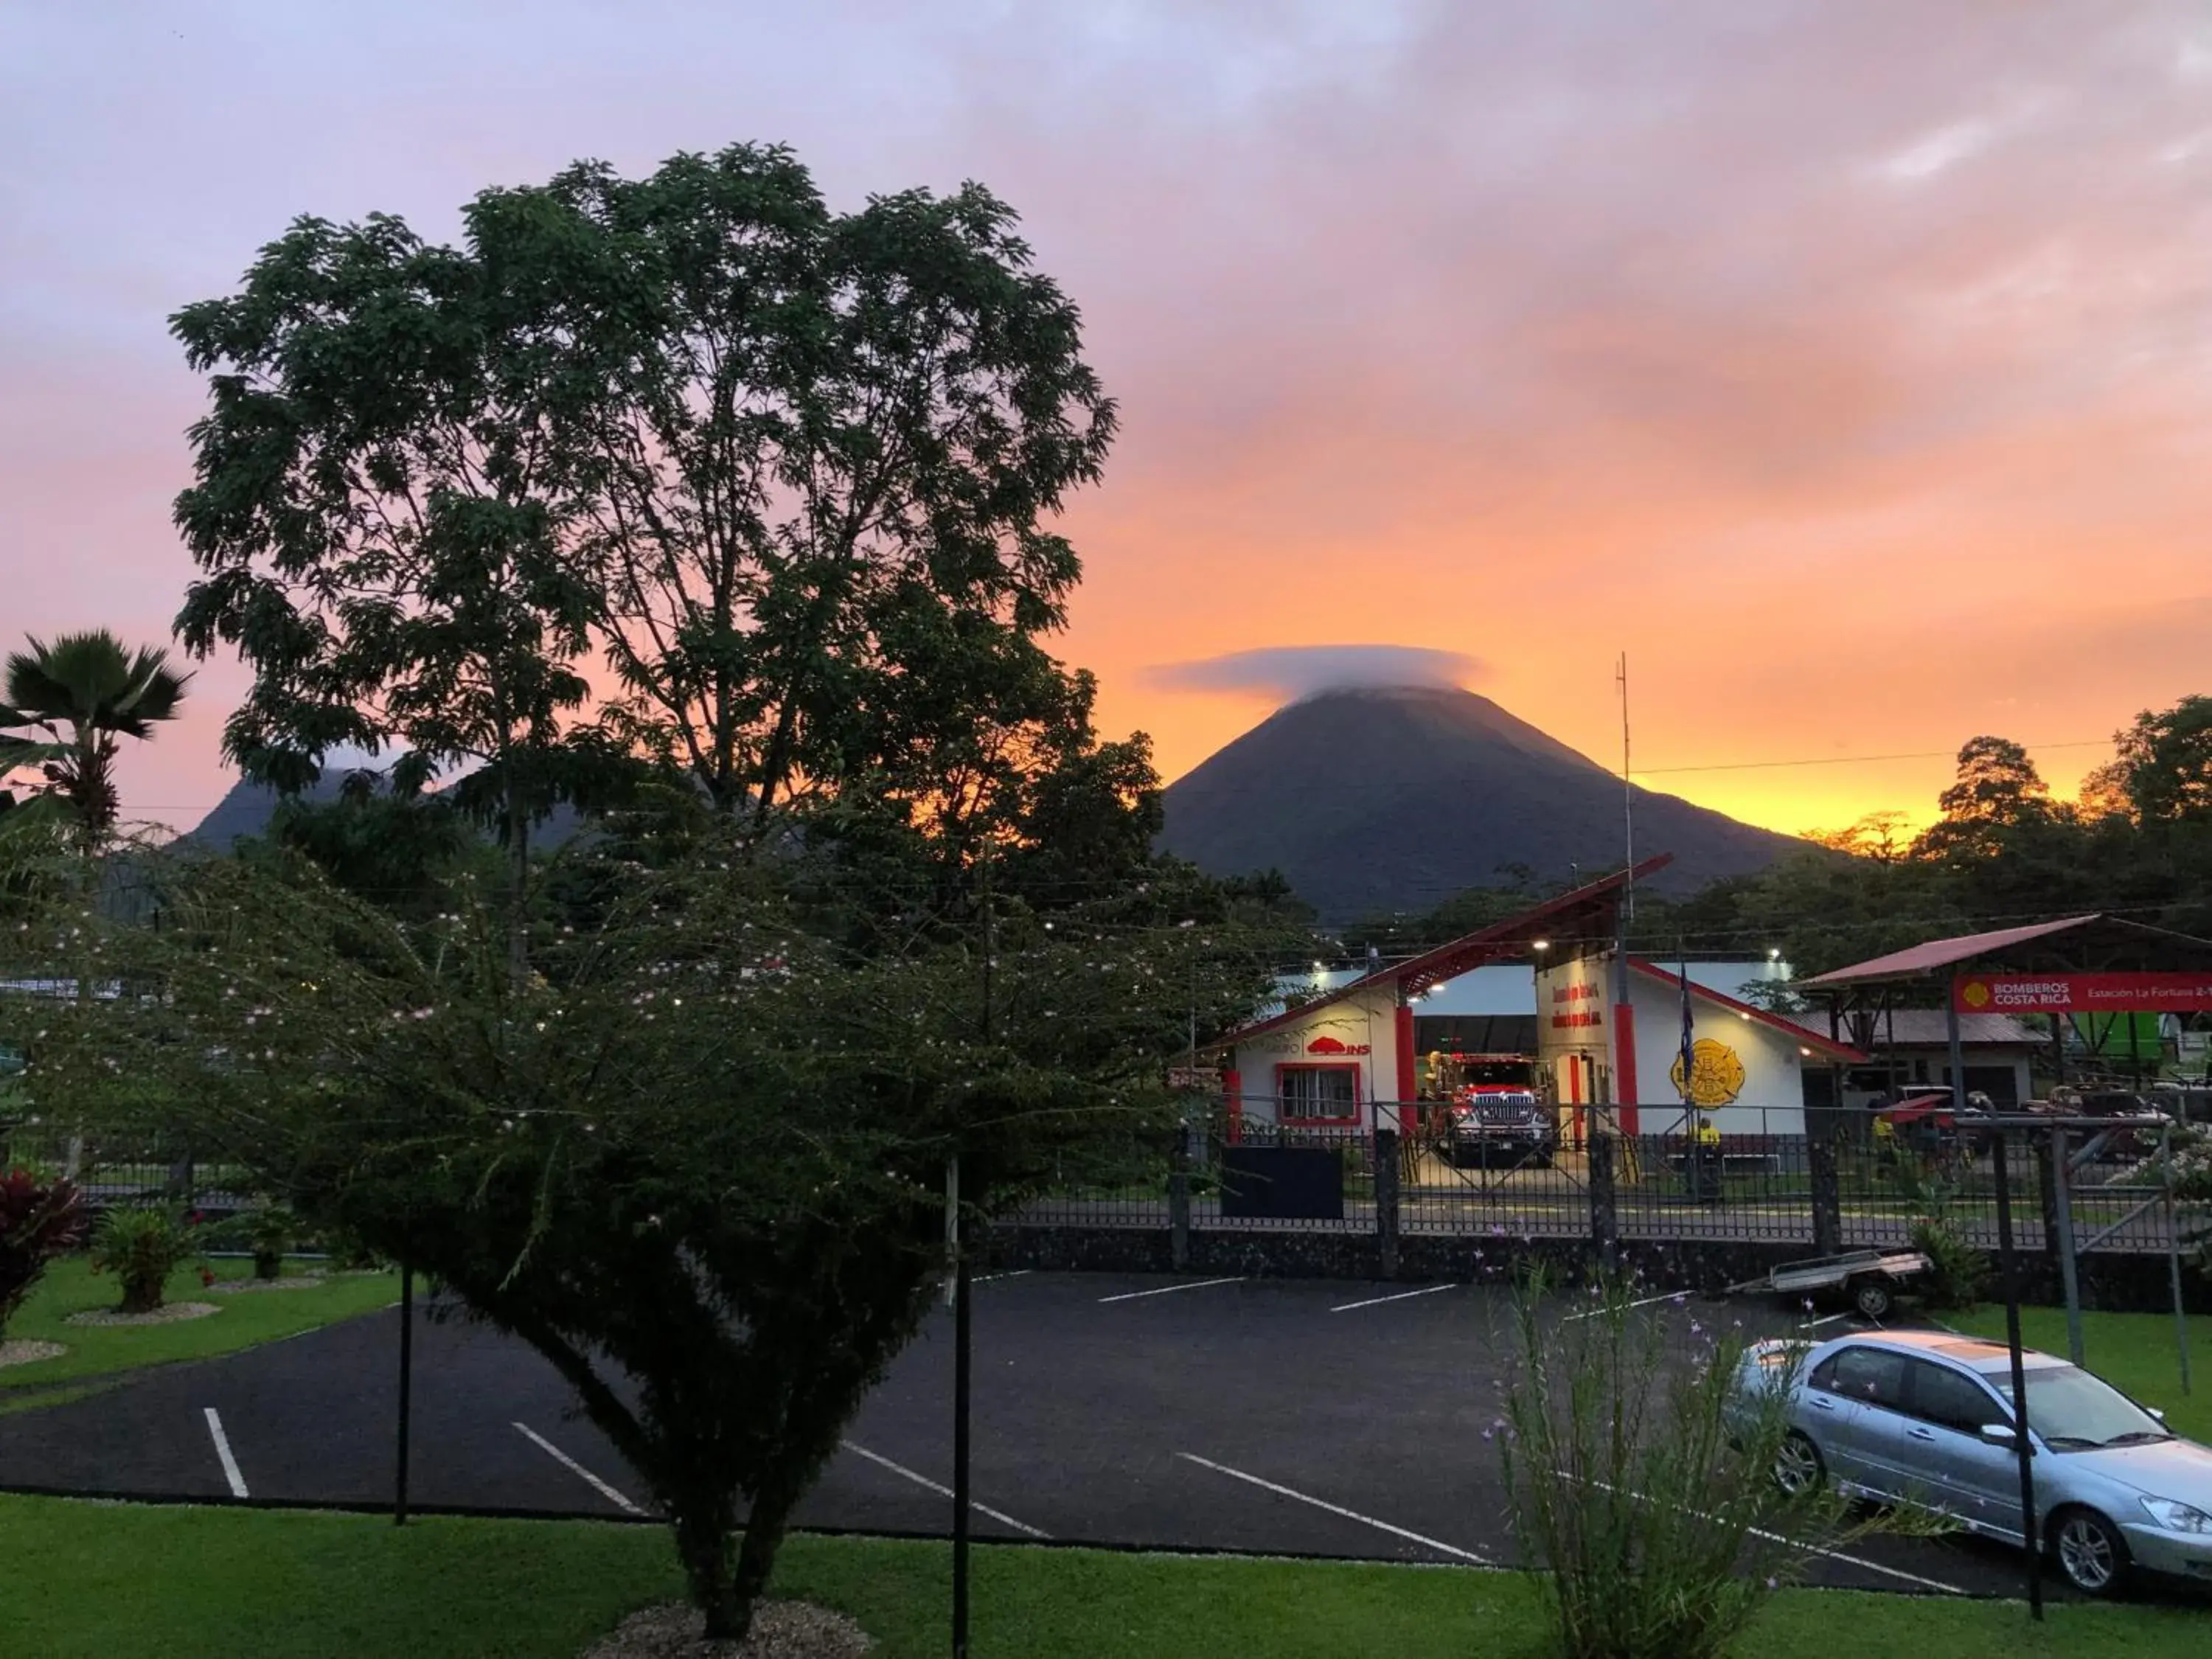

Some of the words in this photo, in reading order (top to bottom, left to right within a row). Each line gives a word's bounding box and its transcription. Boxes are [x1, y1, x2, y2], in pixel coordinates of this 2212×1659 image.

[1994, 983, 2070, 994] BOMBEROS
[1994, 994, 2038, 1004] COSTA
[2040, 993, 2071, 1004] RICA
[1346, 1045, 1371, 1055] INS
